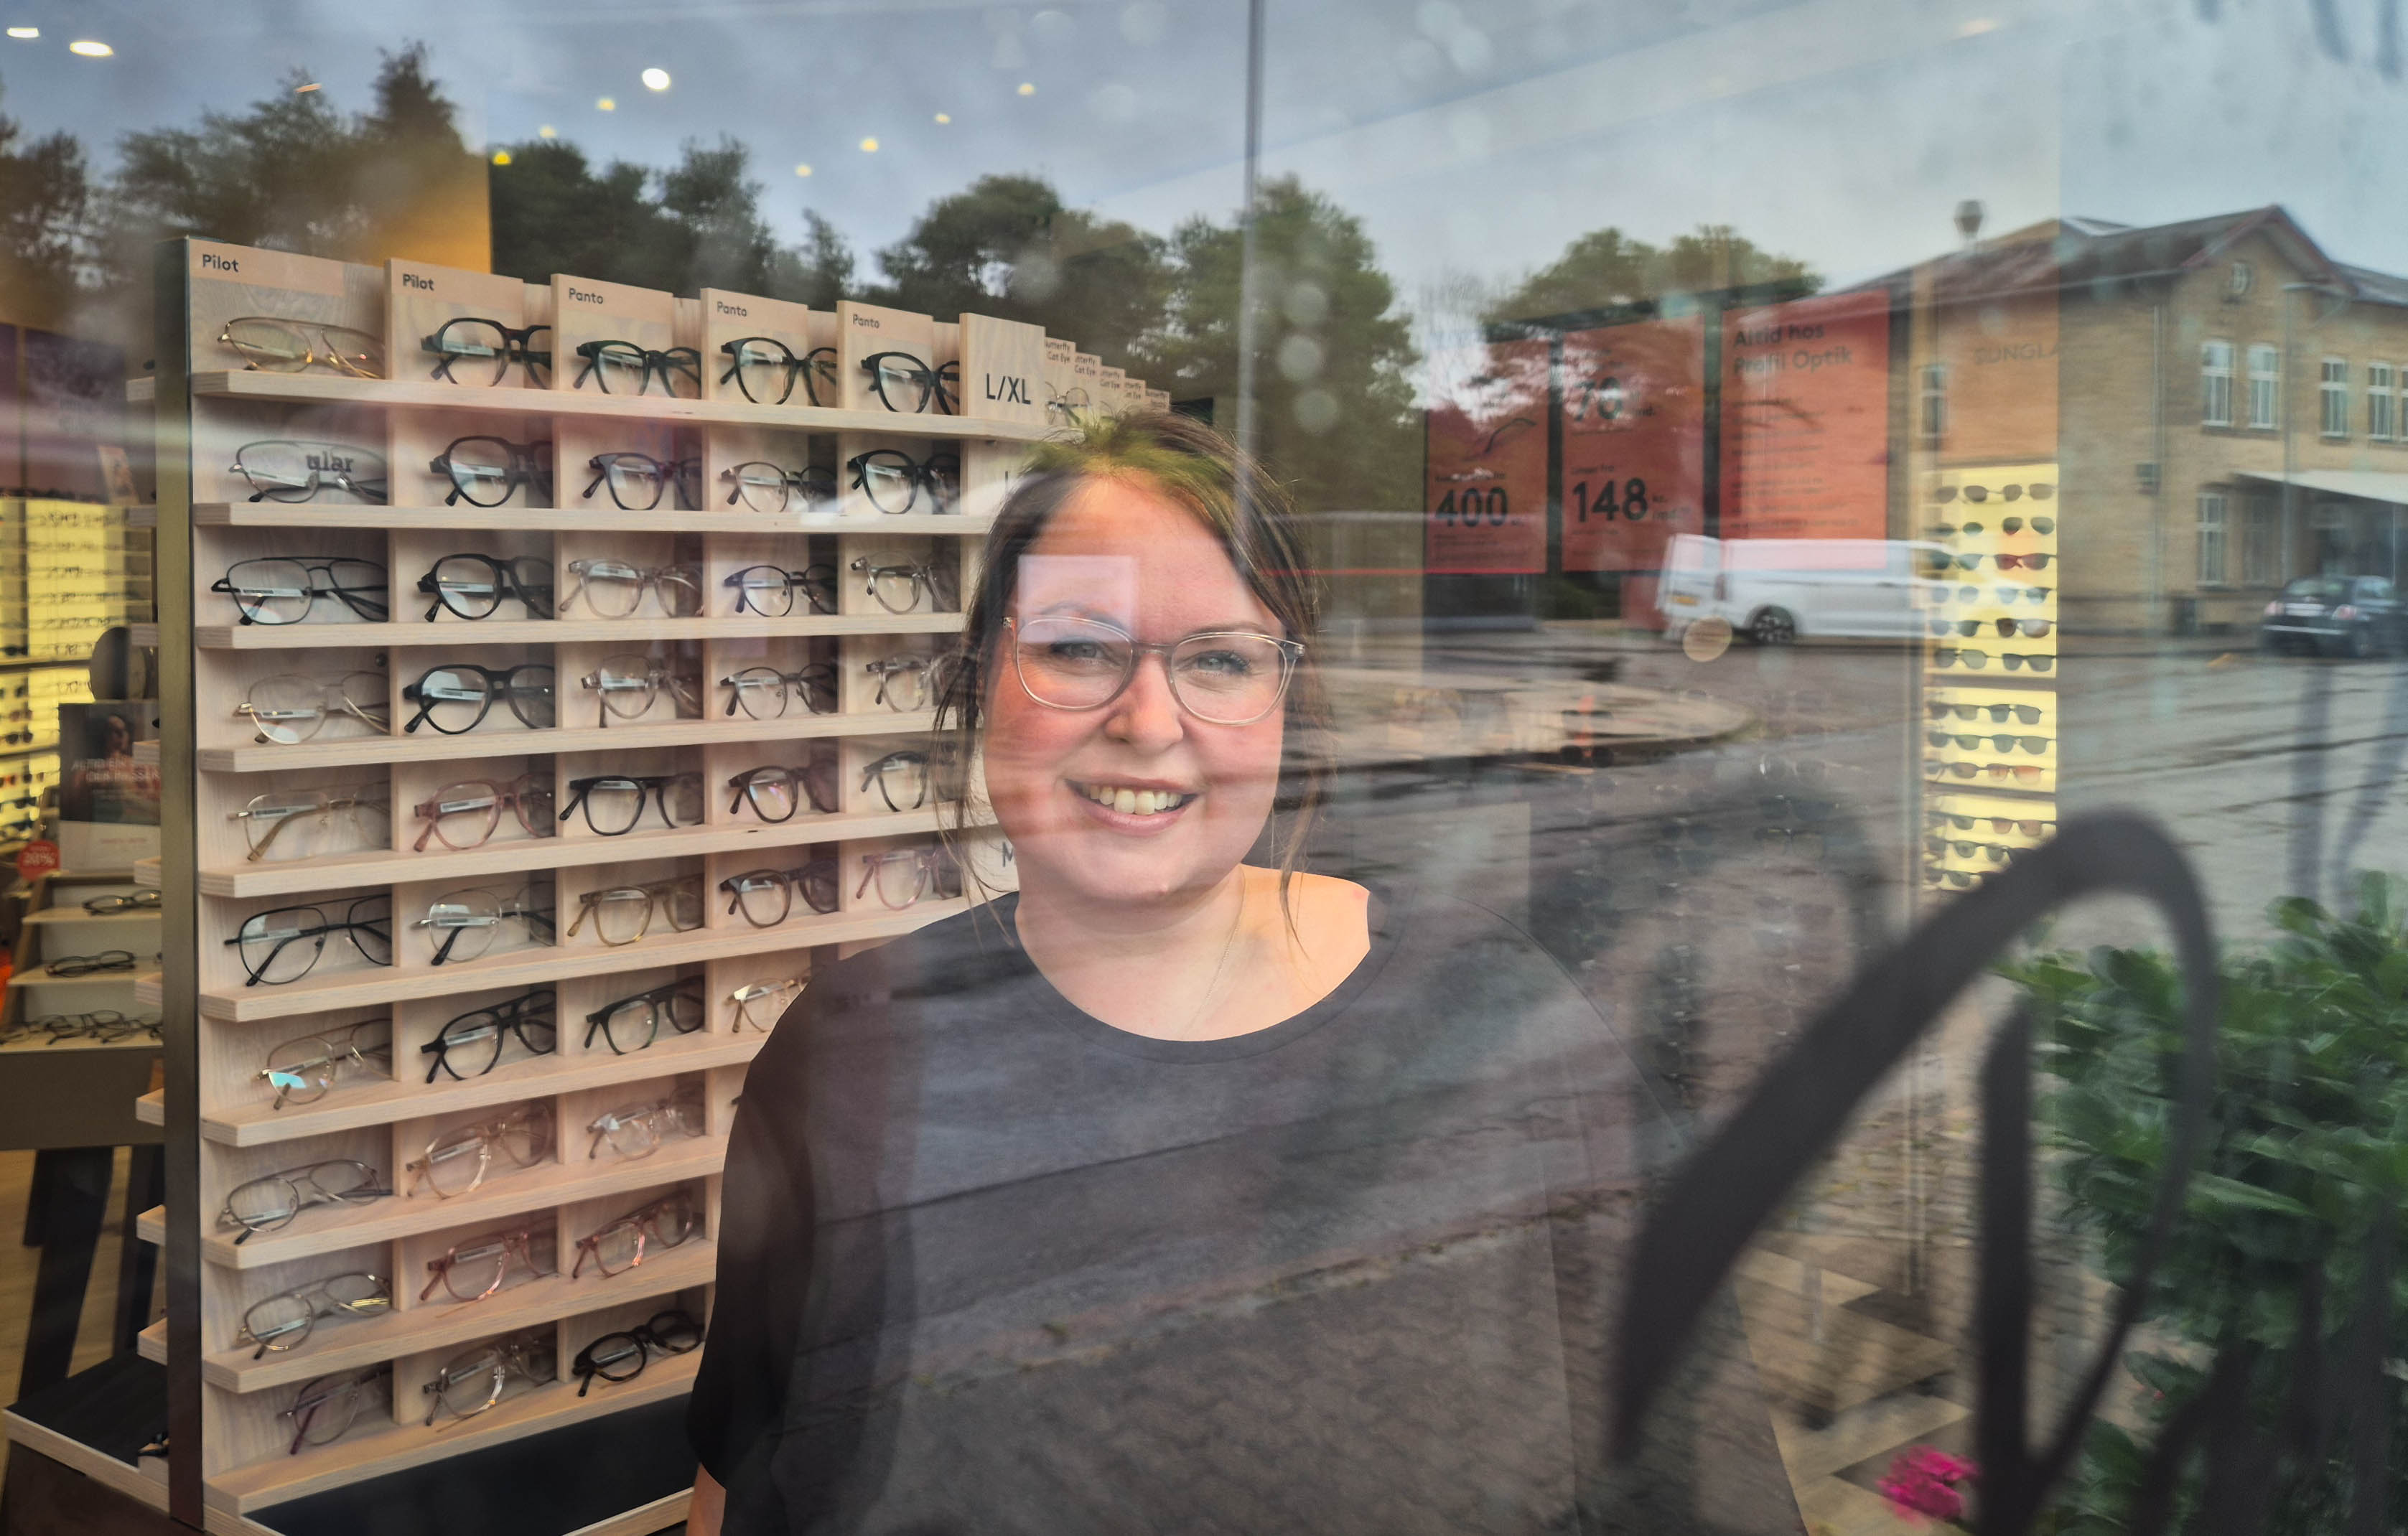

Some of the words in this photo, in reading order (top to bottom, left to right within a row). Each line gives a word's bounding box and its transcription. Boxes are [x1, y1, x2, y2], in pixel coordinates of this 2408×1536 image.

[202, 253, 239, 273] Pilot
[402, 273, 435, 291] Pilot
[568, 287, 604, 305] Panto
[717, 301, 748, 318] Panto
[852, 314, 880, 329] Panto
[1734, 327, 1782, 347] Altid
[1788, 324, 1825, 340] hos
[1047, 351, 1059, 361] Cat
[1060, 353, 1070, 364] Eye
[1792, 346, 1854, 373] Optik
[1074, 365, 1085, 374] Cat
[1086, 366, 1096, 378] Eye
[986, 373, 1031, 405] L/XL
[1435, 486, 1508, 528] 400
[1572, 477, 1648, 523] 148
